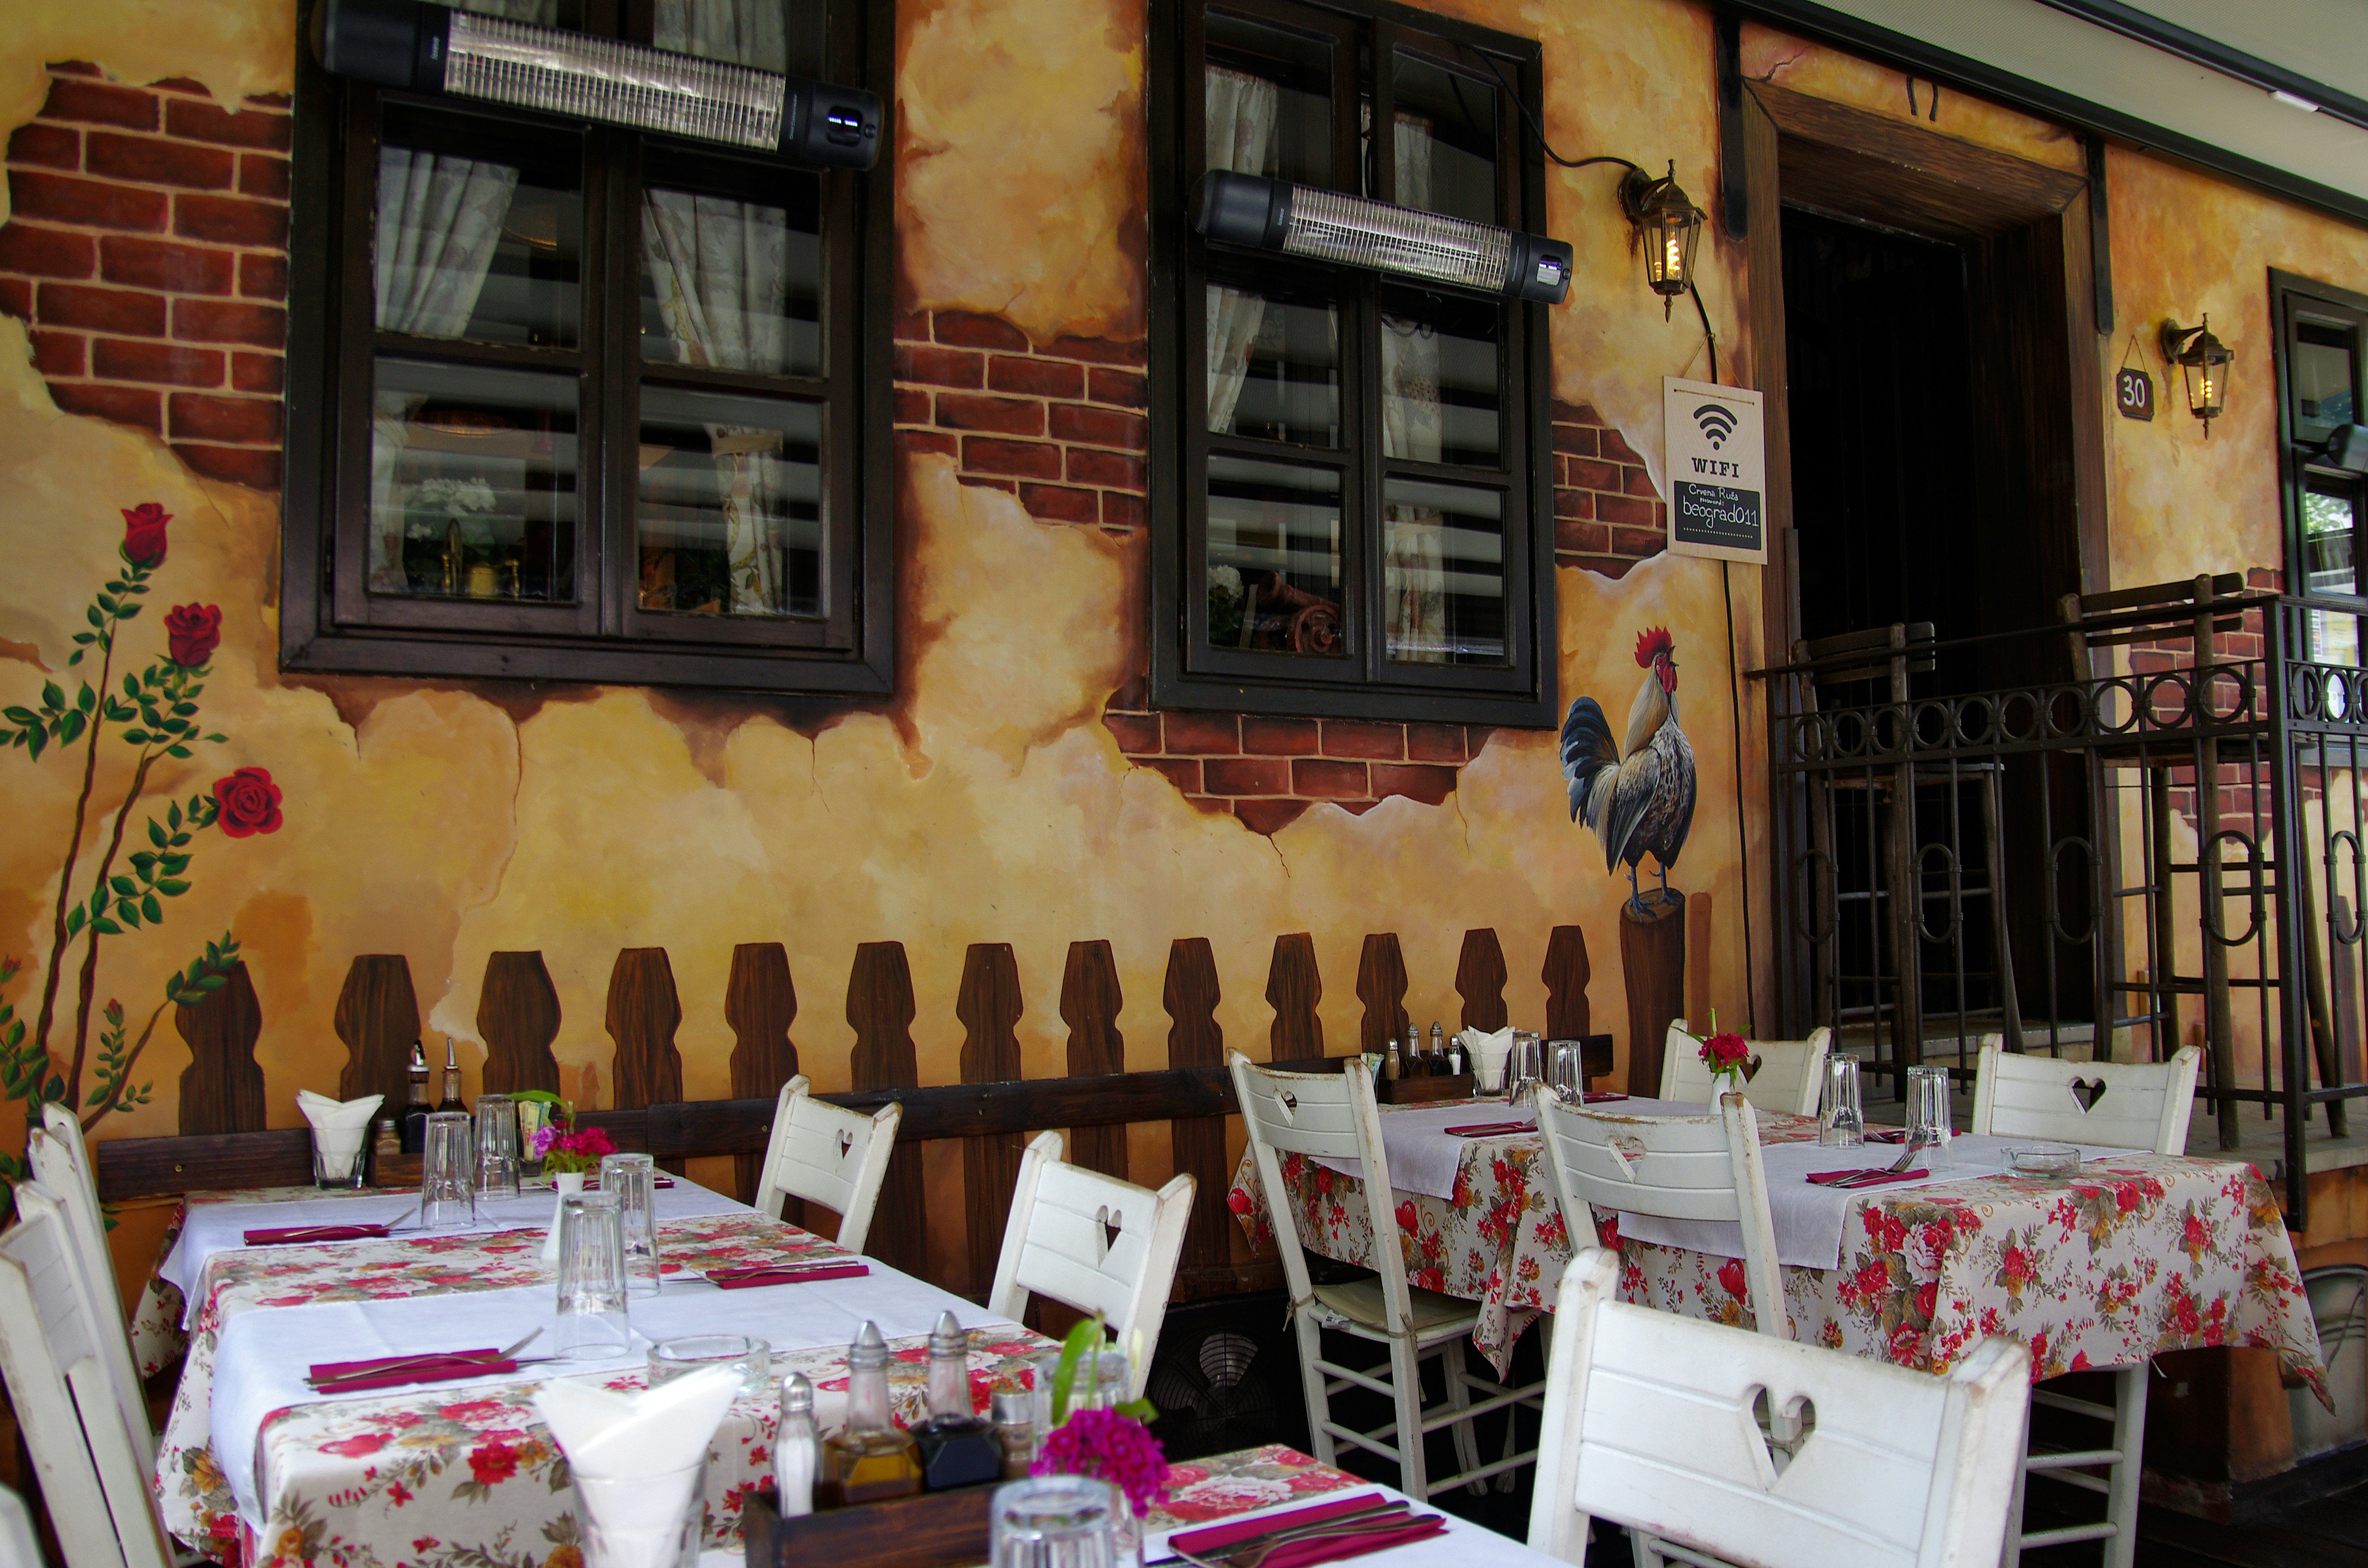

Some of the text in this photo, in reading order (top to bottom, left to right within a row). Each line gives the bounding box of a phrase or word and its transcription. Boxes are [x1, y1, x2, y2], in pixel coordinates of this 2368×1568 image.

[2123, 375, 2146, 408] 30
[1691, 457, 1739, 478] WIFI
[1689, 483, 1739, 502] Crvena Ruža
[1683, 495, 1759, 529] beograd011
